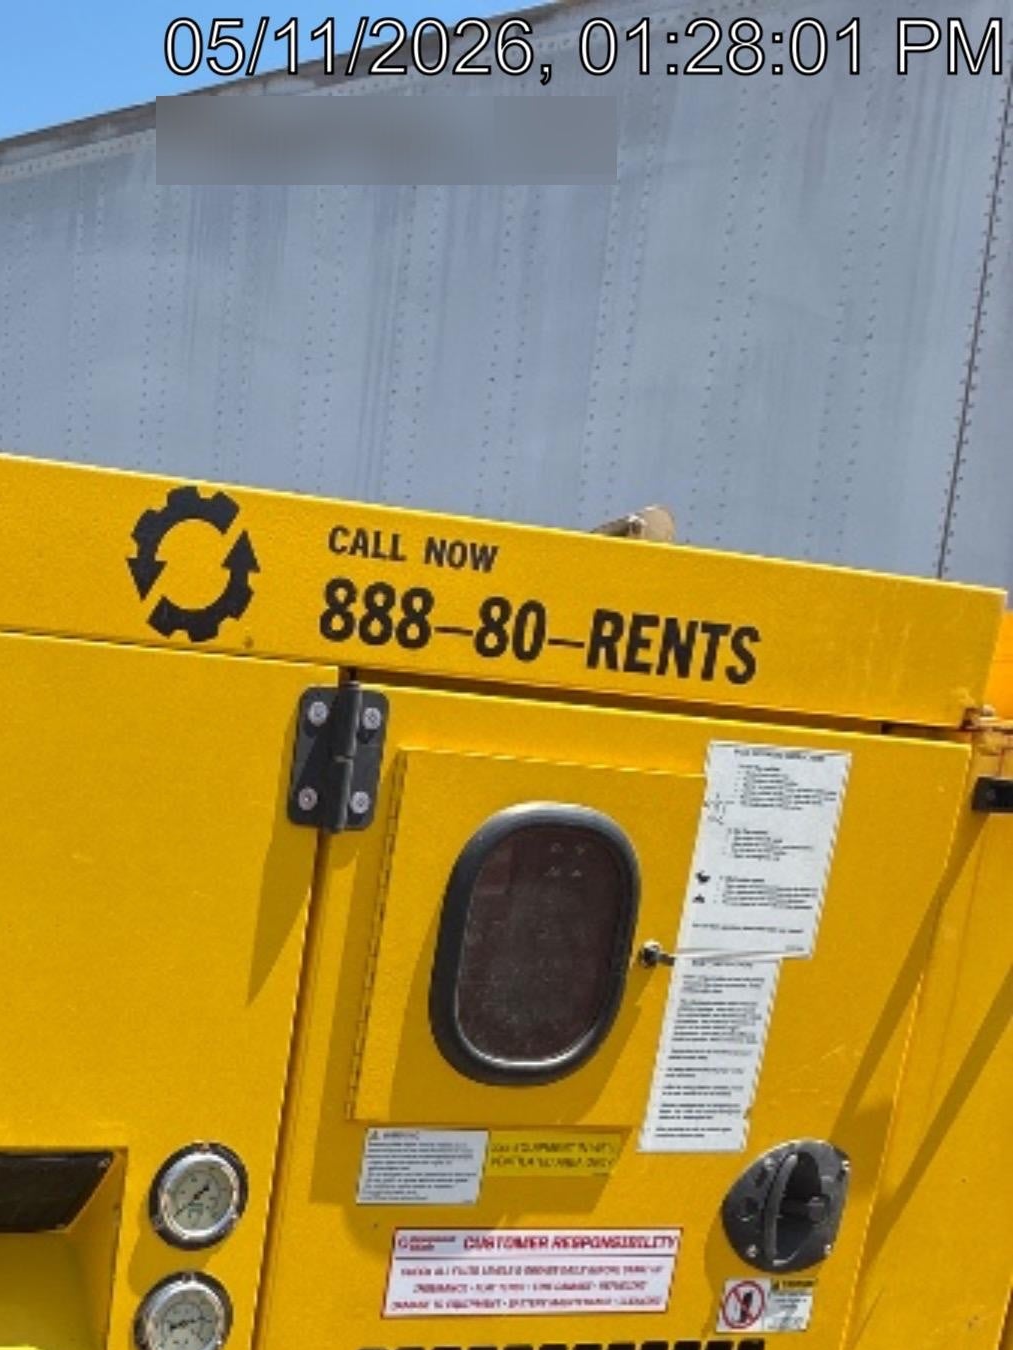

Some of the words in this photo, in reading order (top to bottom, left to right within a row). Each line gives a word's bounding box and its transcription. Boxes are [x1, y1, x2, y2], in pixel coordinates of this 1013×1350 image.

[328, 525, 407, 562] CALL
[424, 536, 500, 572] NOW
[319, 576, 762, 686] 888-80-RENTS
[464, 1235, 549, 1251] CUSTOMER
[552, 1235, 678, 1249] RESPONSIBILITY
